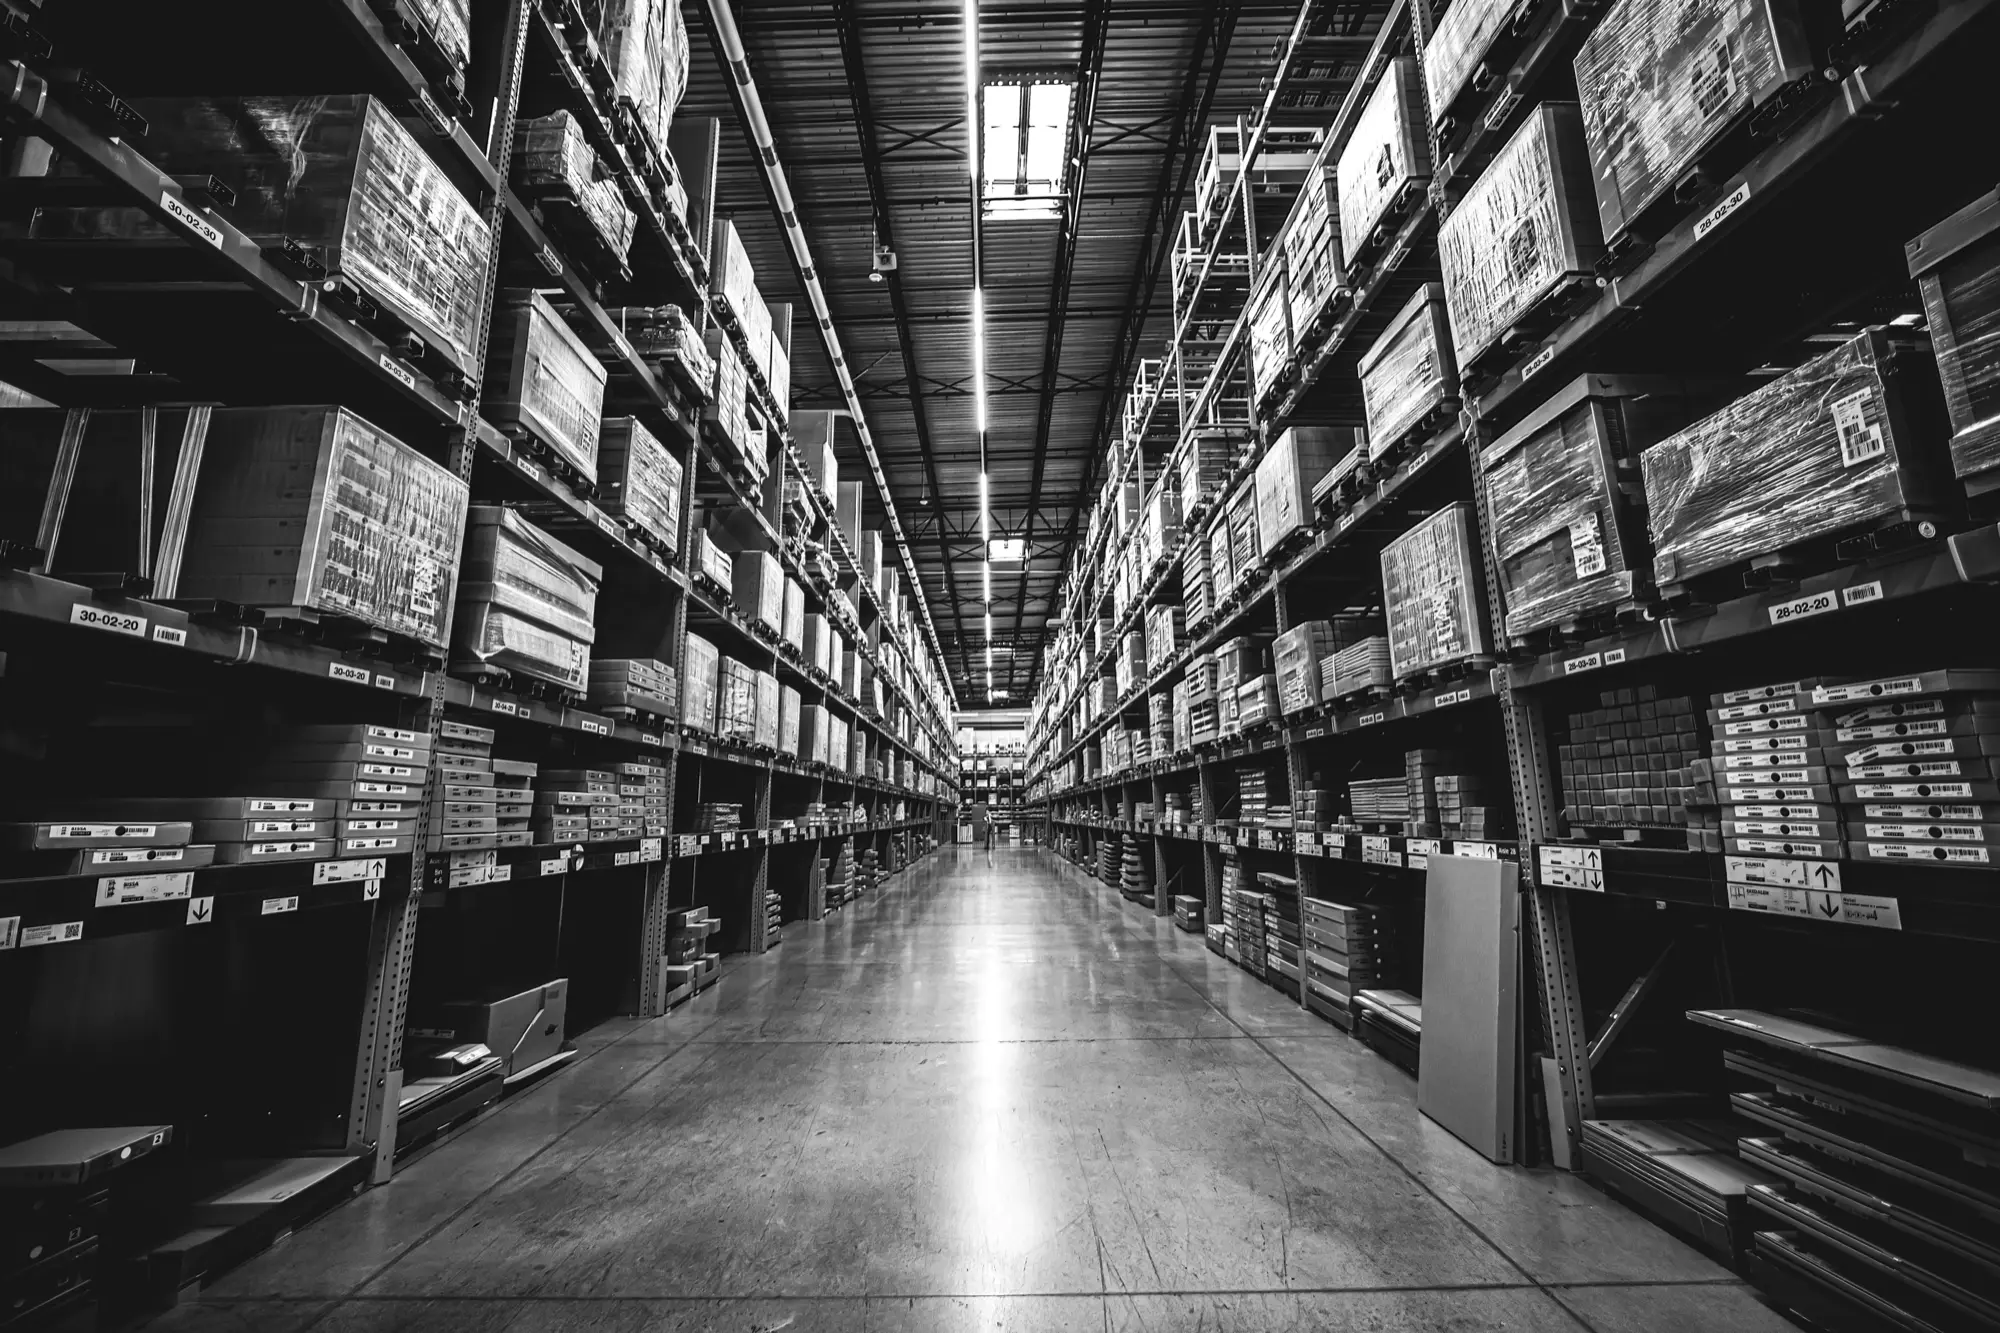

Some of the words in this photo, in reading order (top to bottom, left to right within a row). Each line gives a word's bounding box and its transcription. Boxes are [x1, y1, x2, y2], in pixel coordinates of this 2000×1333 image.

[168, 201, 216, 241] 30-02-30
[1699, 192, 1743, 233] 28-02-30
[383, 360, 411, 384] 30-03-30
[1525, 351, 1549, 376] 28-03-30
[1776, 597, 1829, 619] 28-02-20
[80, 610, 139, 631] 30-02-20
[334, 666, 365, 681] 30-03-20
[1568, 657, 1597, 671] 28-03-20
[155, 1134, 161, 1143] 2
